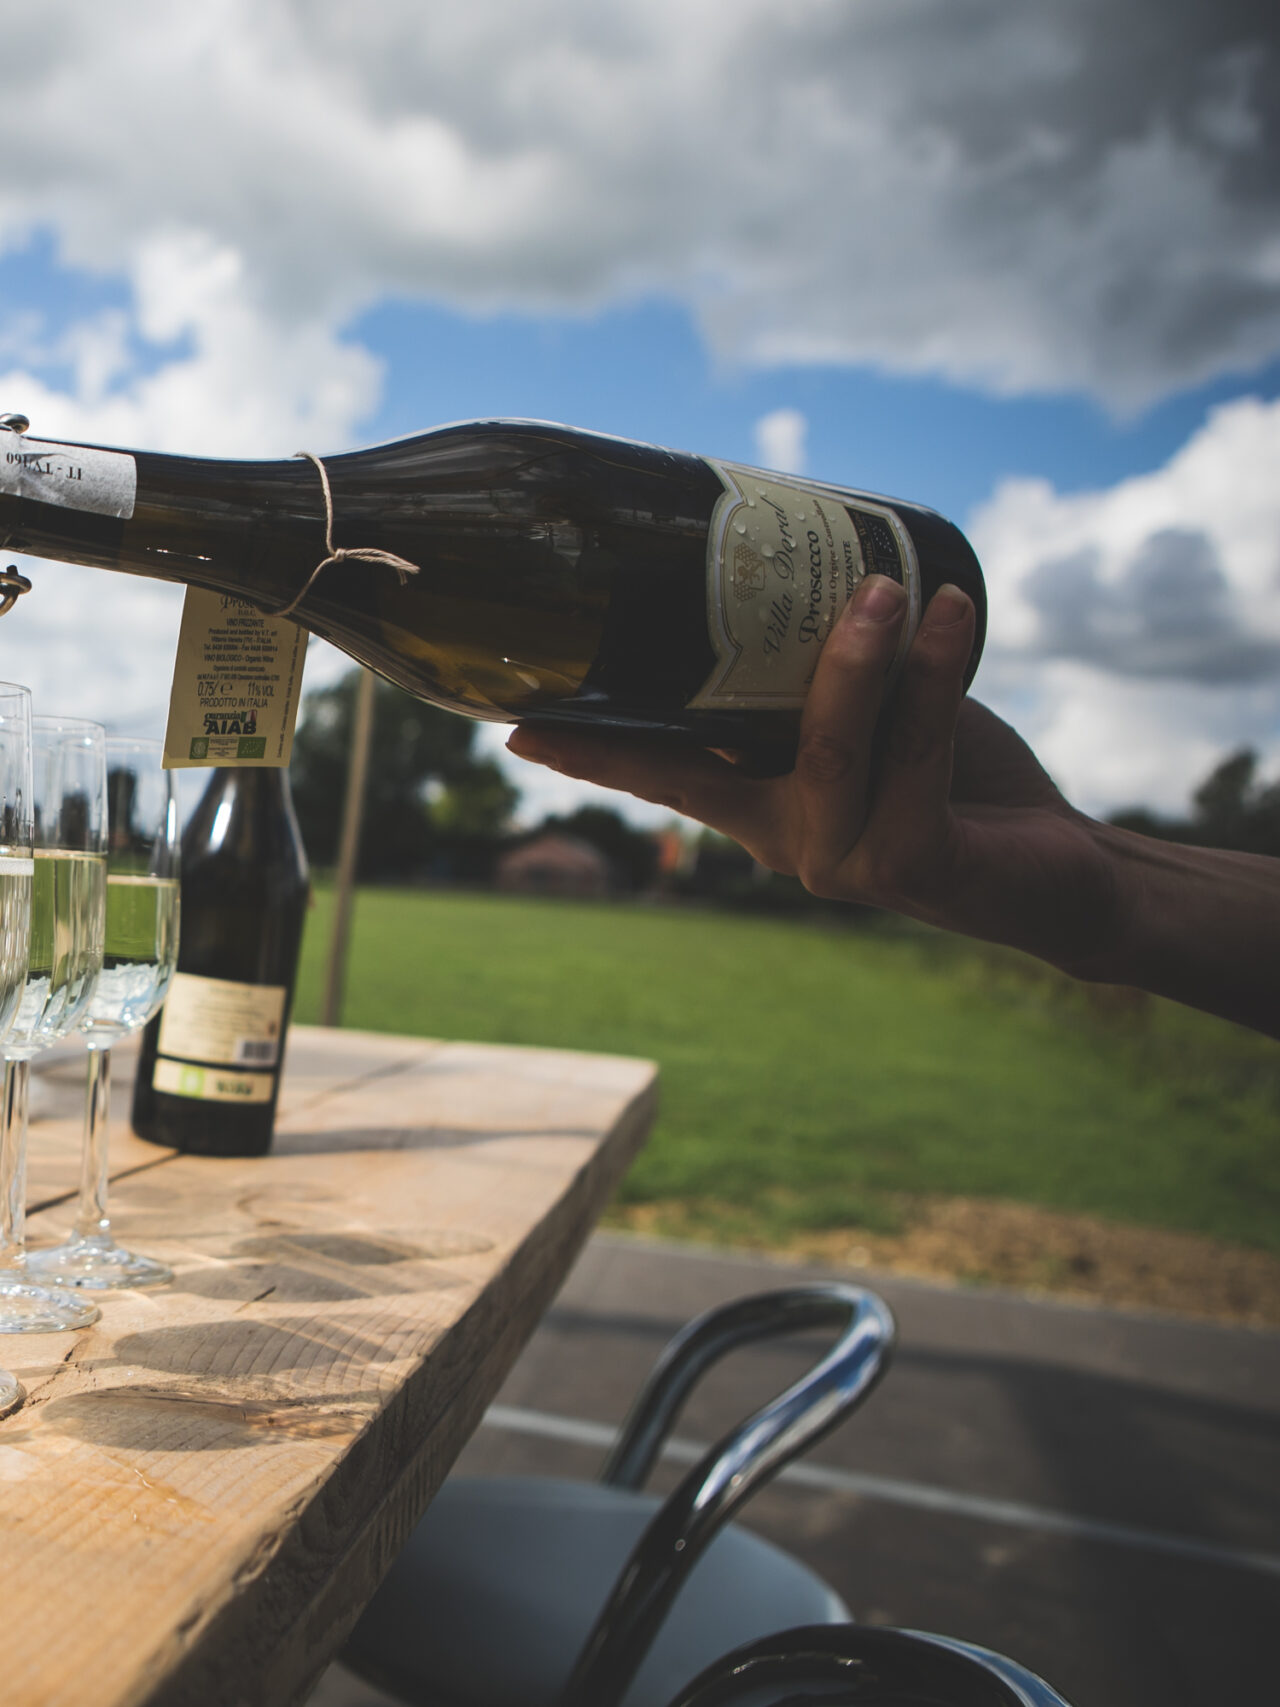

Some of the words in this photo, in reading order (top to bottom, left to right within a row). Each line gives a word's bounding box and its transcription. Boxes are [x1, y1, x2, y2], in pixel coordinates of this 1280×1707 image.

[66, 467, 82, 481] IT
[760, 495, 796, 581] Doral
[798, 530, 824, 644] Prosecco
[828, 550, 840, 588] Origine
[842, 540, 854, 601] RIZZANTE
[829, 591, 837, 604] di
[763, 591, 796, 656] Villa
[200, 698, 237, 708] PRODOTTO
[238, 698, 246, 707] IN
[246, 698, 268, 708] ITALIA
[205, 720, 257, 735] AIAB
